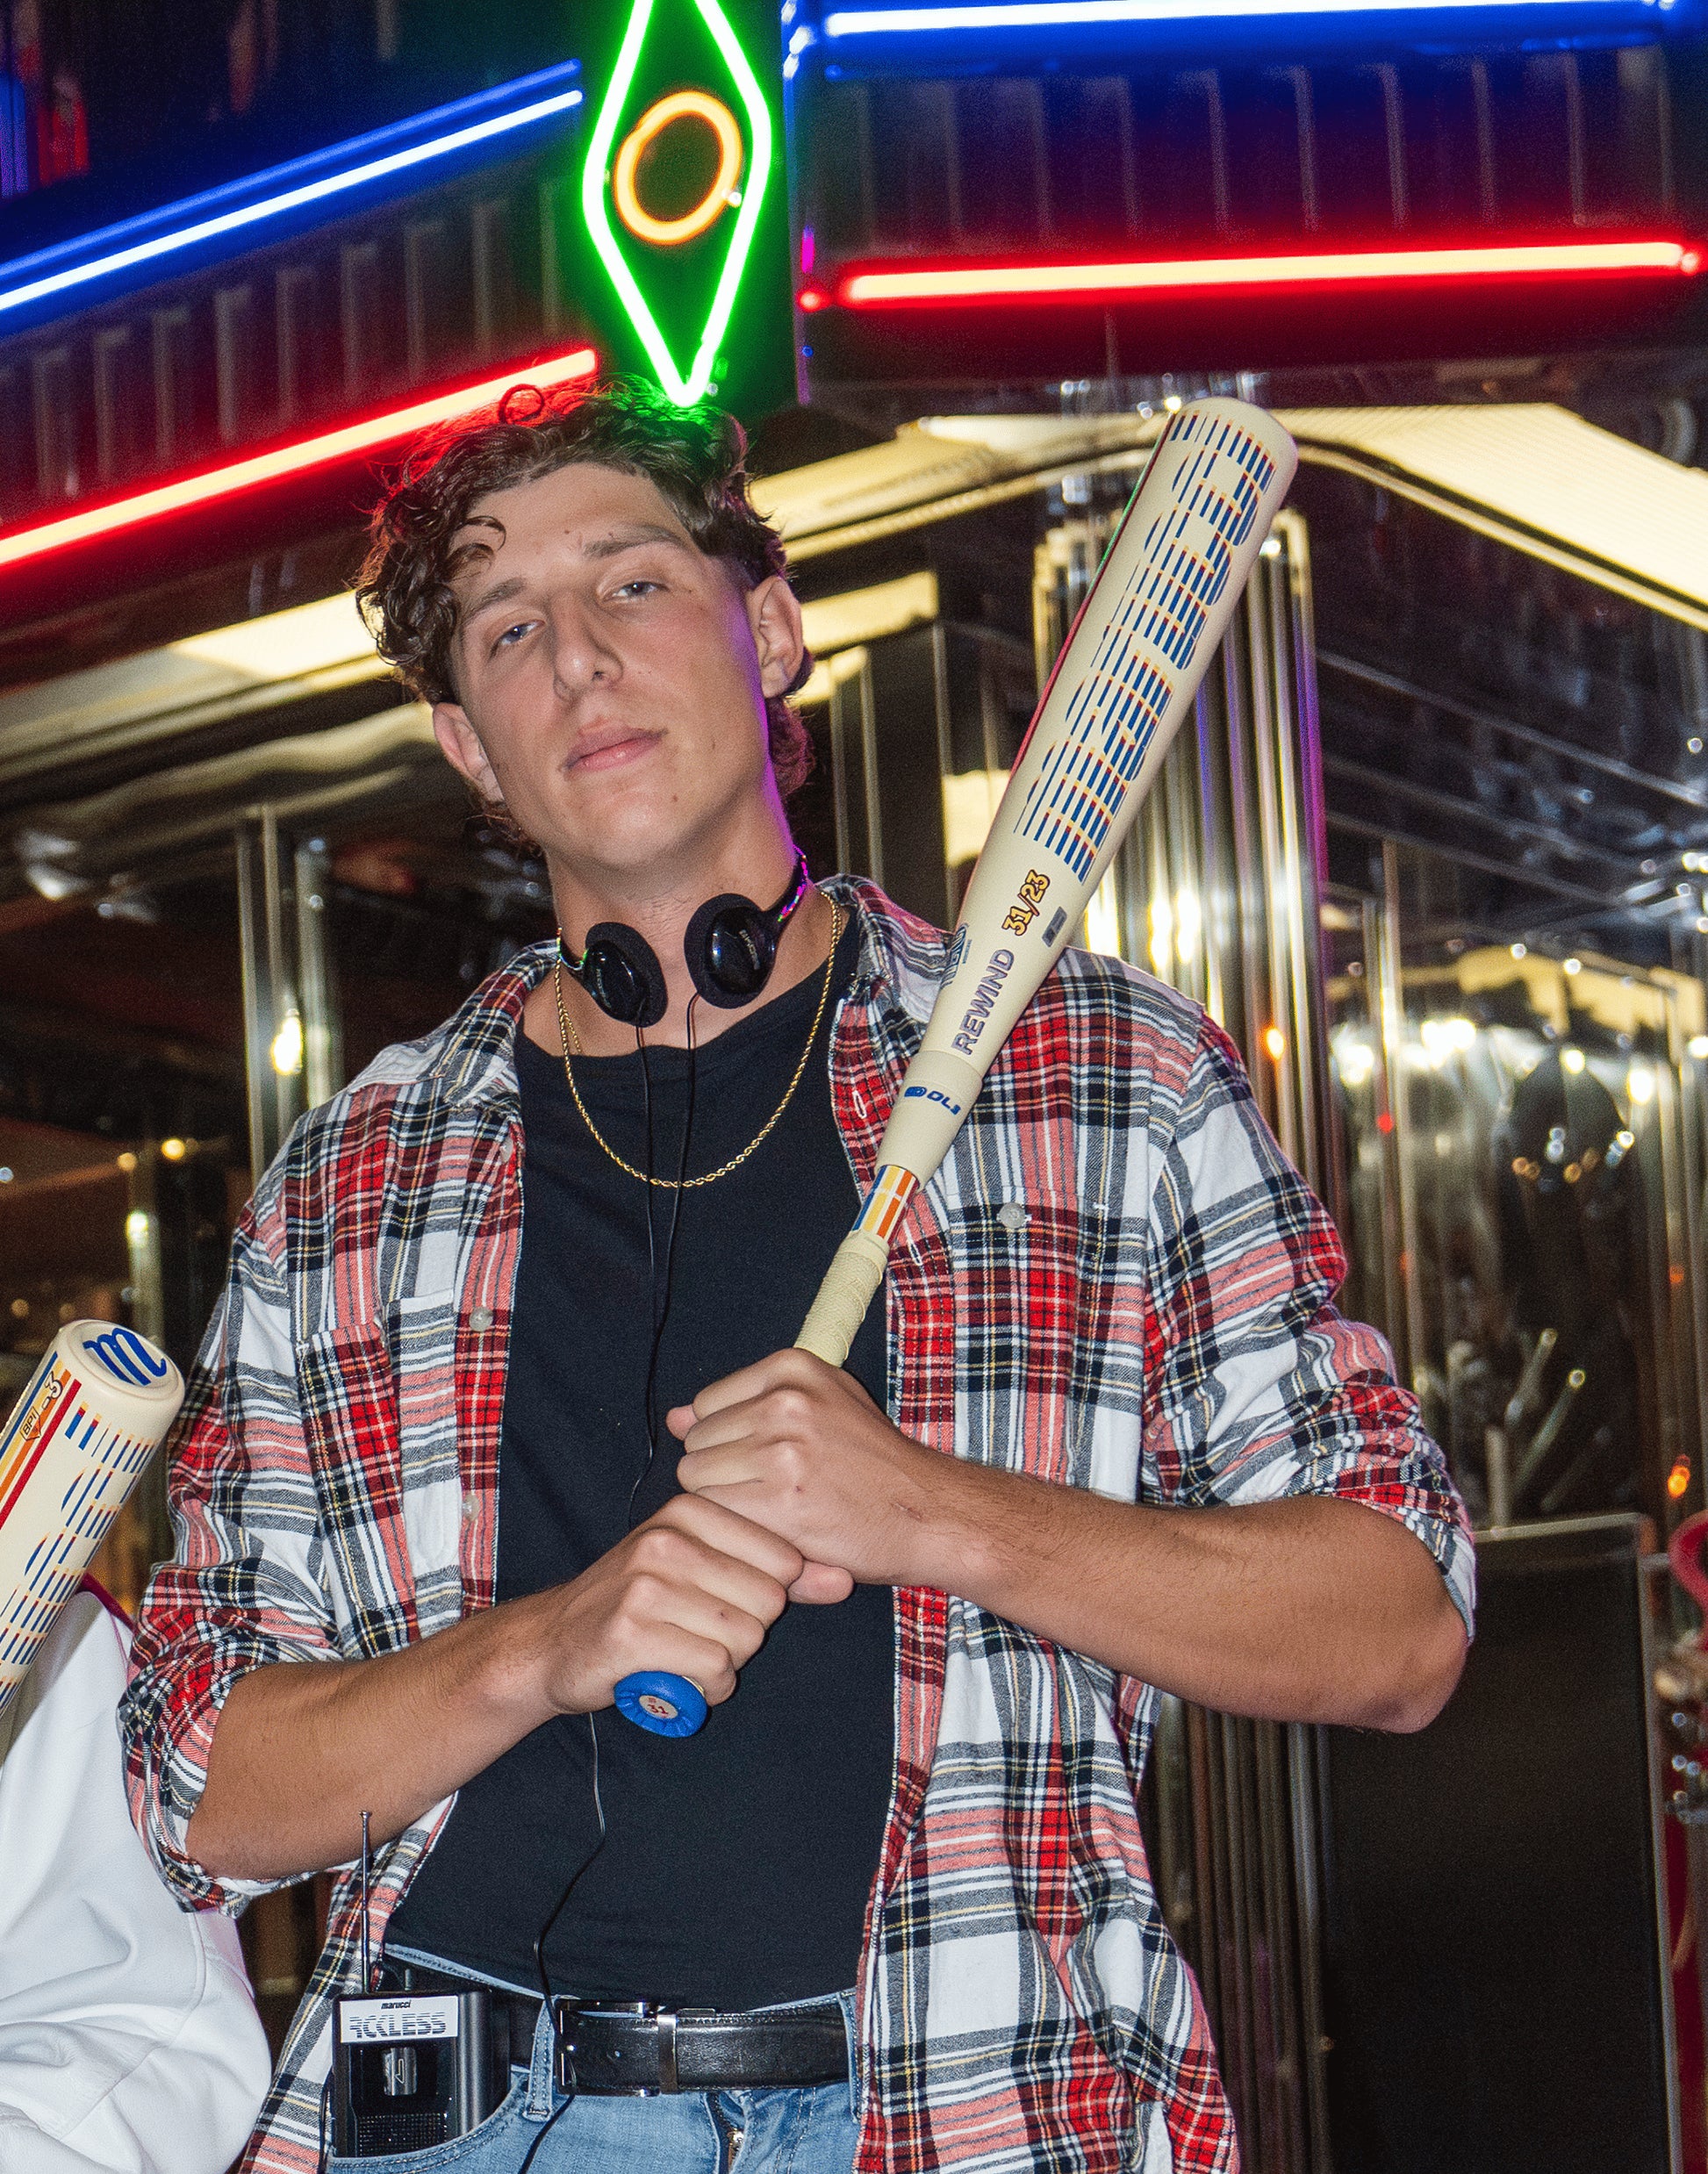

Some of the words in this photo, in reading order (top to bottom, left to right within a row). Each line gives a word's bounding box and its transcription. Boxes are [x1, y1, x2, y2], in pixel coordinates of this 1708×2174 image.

[1001, 869, 1051, 936] 31/23
[951, 949, 1015, 1056] REWIND
[381, 1999, 412, 2010] marucci
